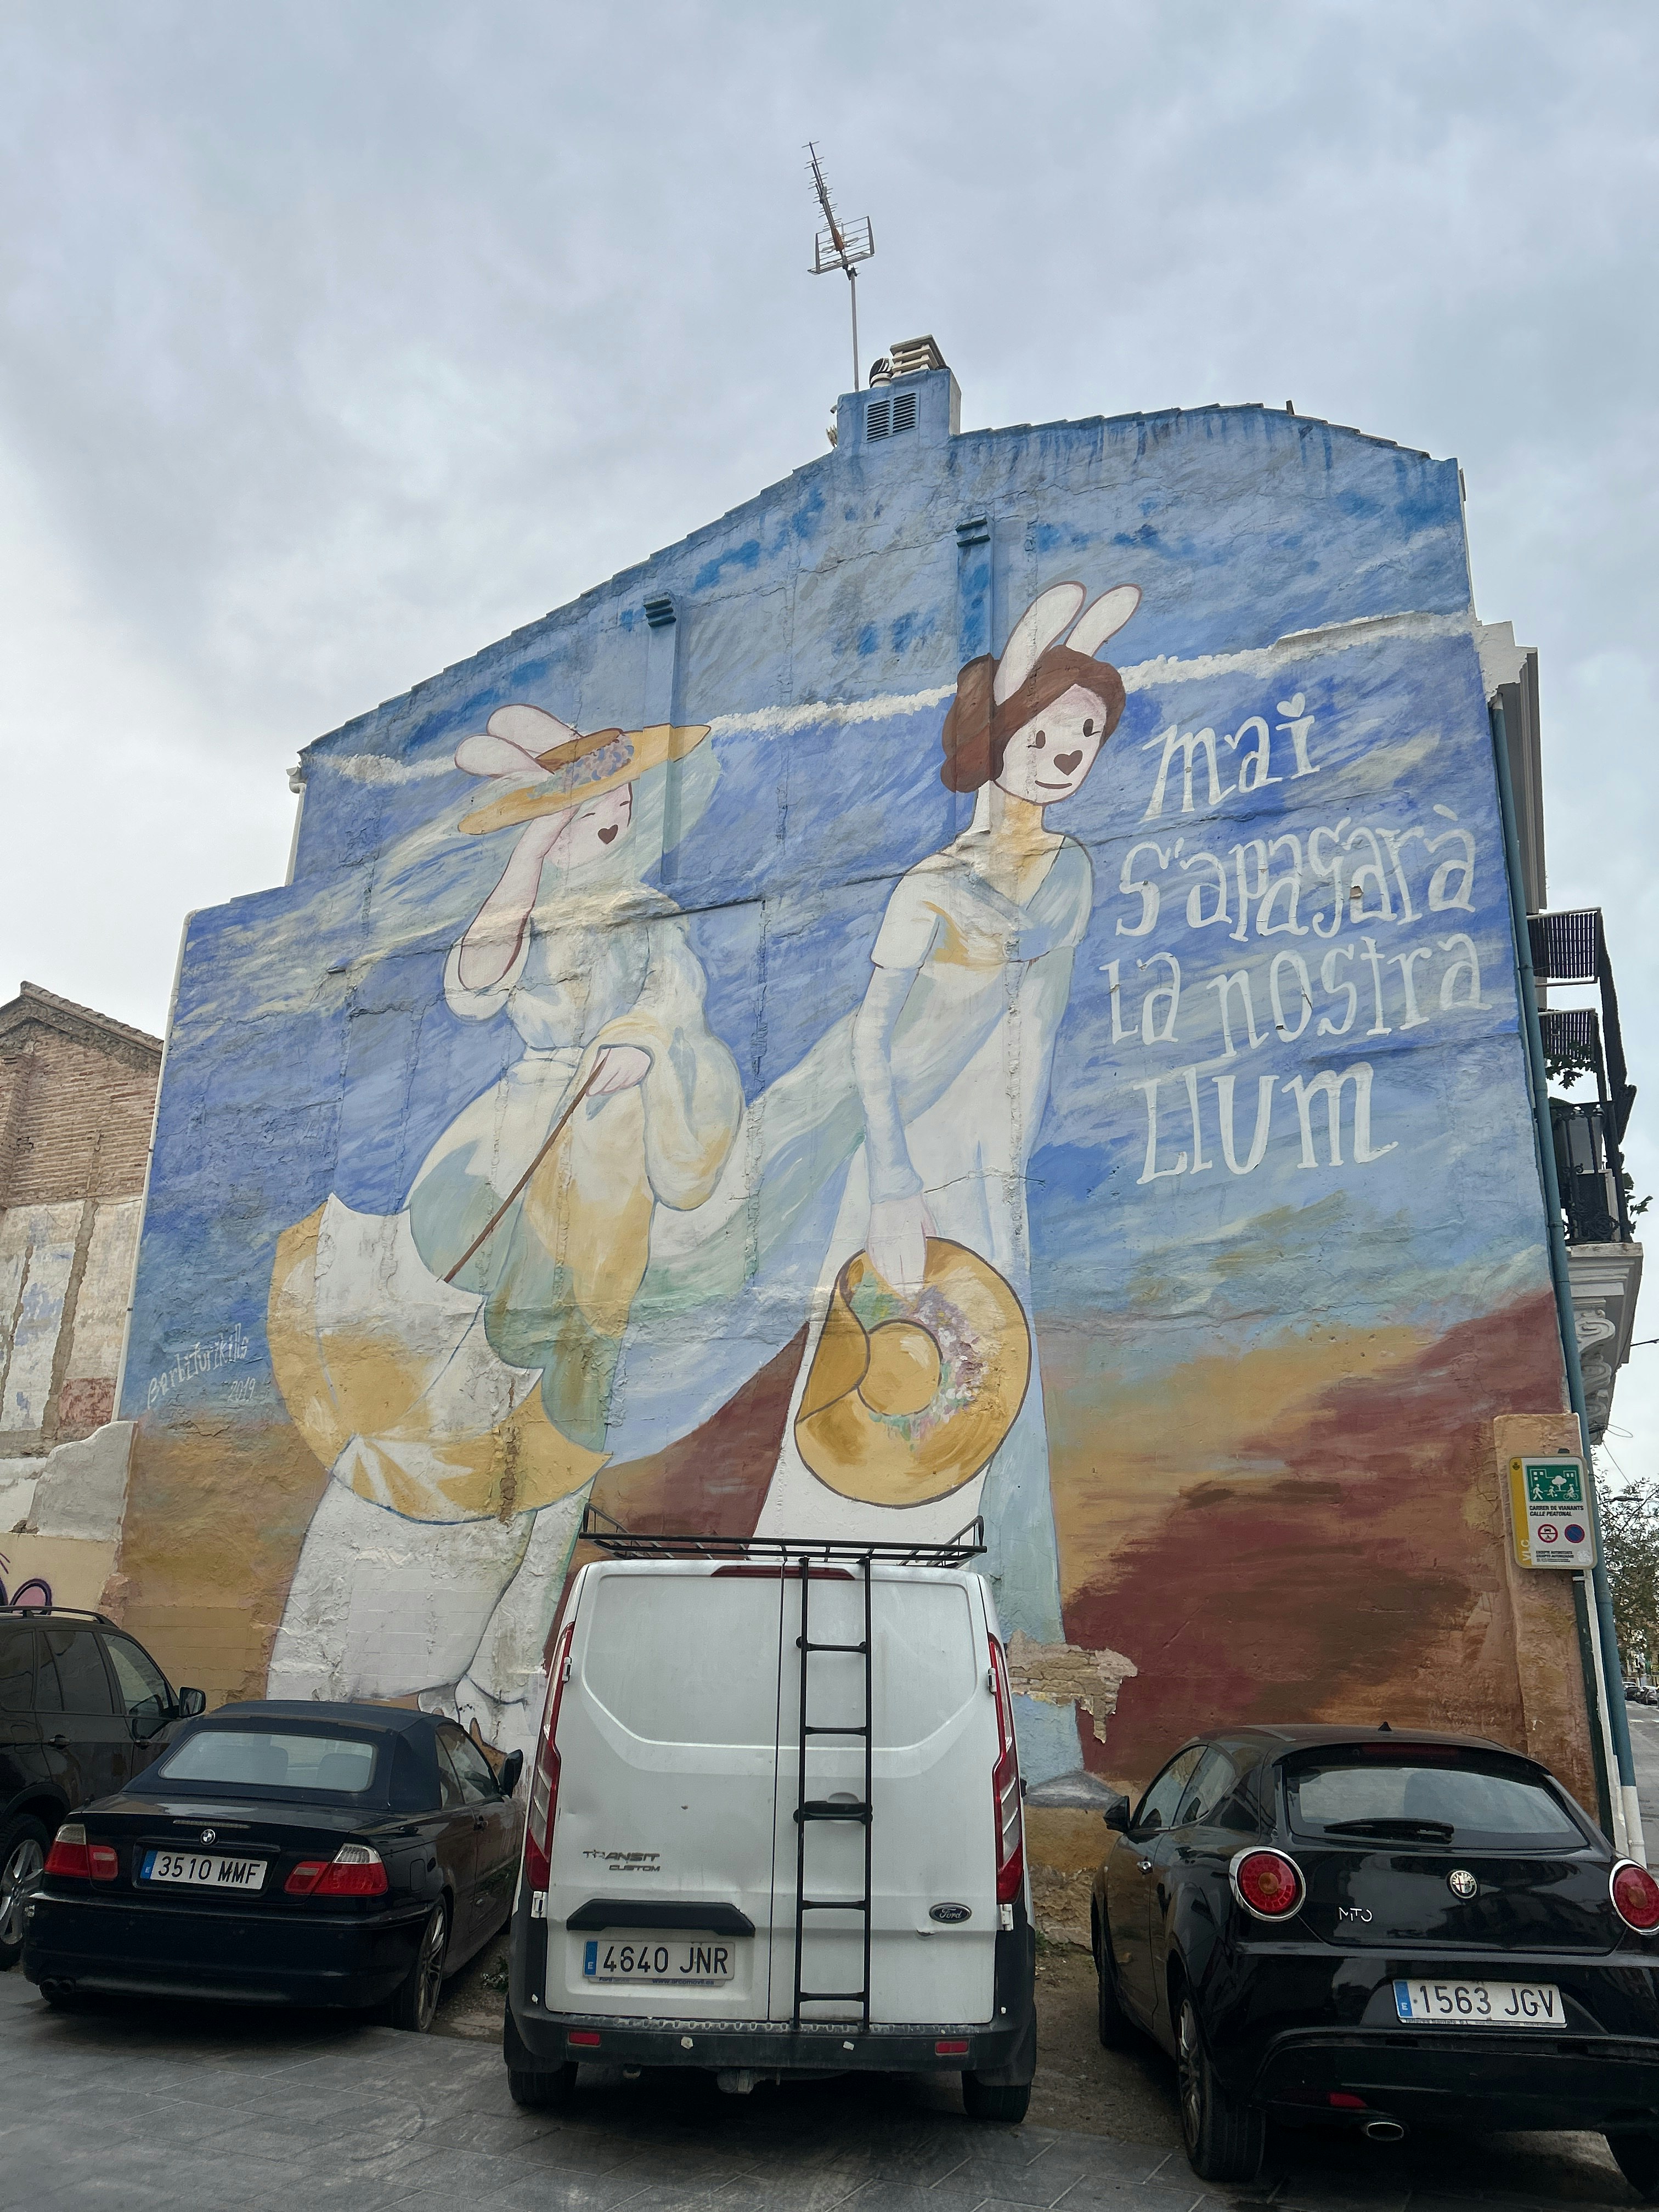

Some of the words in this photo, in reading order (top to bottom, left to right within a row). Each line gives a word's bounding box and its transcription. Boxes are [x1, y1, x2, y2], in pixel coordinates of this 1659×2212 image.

[227, 1376, 256, 1402] 2019
[1520, 1539, 1532, 1561] VLC
[582, 1849, 660, 1861] TRANSIT
[158, 1856, 212, 1880] 3510
[217, 1860, 261, 1884] MMF
[939, 1908, 963, 1919] Ford
[588, 1961, 594, 1970] E
[603, 1946, 669, 1973] 4640
[679, 1947, 728, 1974] JNR
[1401, 2002, 1408, 2011] E
[1420, 1985, 1492, 2015] 1563
[1504, 1988, 1553, 2018] JGV
